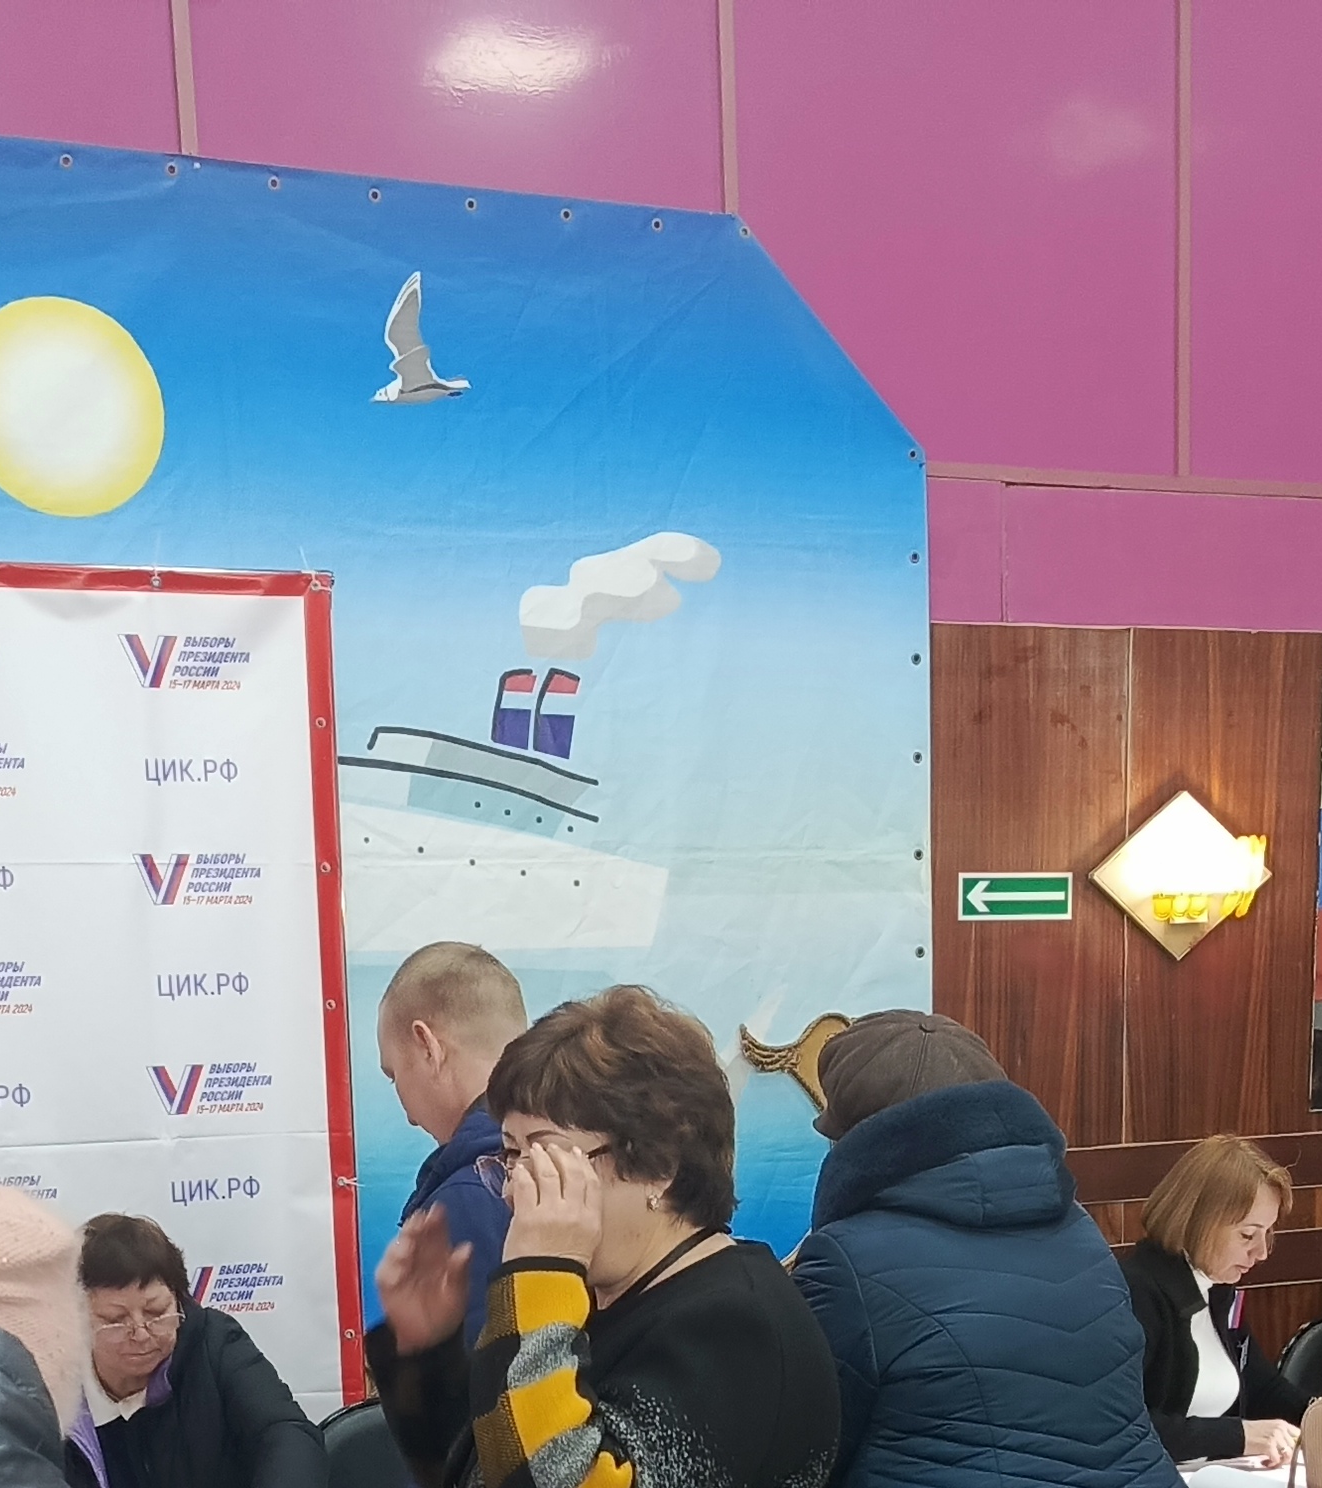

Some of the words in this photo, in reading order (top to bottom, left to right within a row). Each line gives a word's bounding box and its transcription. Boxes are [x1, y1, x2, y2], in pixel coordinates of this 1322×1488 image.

[183, 635, 237, 649] ВЫБОРЫ
[177, 650, 251, 665] ПРЕЗИДЕНТА
[172, 664, 220, 678] РОССИИ
[192, 679, 219, 691] МАРТА
[144, 757, 239, 786] ЦИК.РФ
[195, 852, 246, 865] ВЫБОРЫ
[190, 867, 262, 882] ПРЕЗИДЕНТА
[185, 881, 232, 894] РОССИИ
[206, 894, 232, 906] МАРТА
[157, 971, 250, 1001] ЦИК.РФ
[208, 1061, 257, 1074] ВЫБОРЫ
[204, 1074, 273, 1090] ПРЕЗИДЕНТА
[199, 1088, 243, 1102] РОССИИ
[218, 1102, 244, 1114] МАРТА
[170, 1174, 261, 1207] ЦИК.РФ
[218, 1263, 269, 1275] ВЫБОРЫ
[213, 1275, 284, 1290] ПРЕЗИДЕНТА
[208, 1290, 254, 1303] РОССИИ
